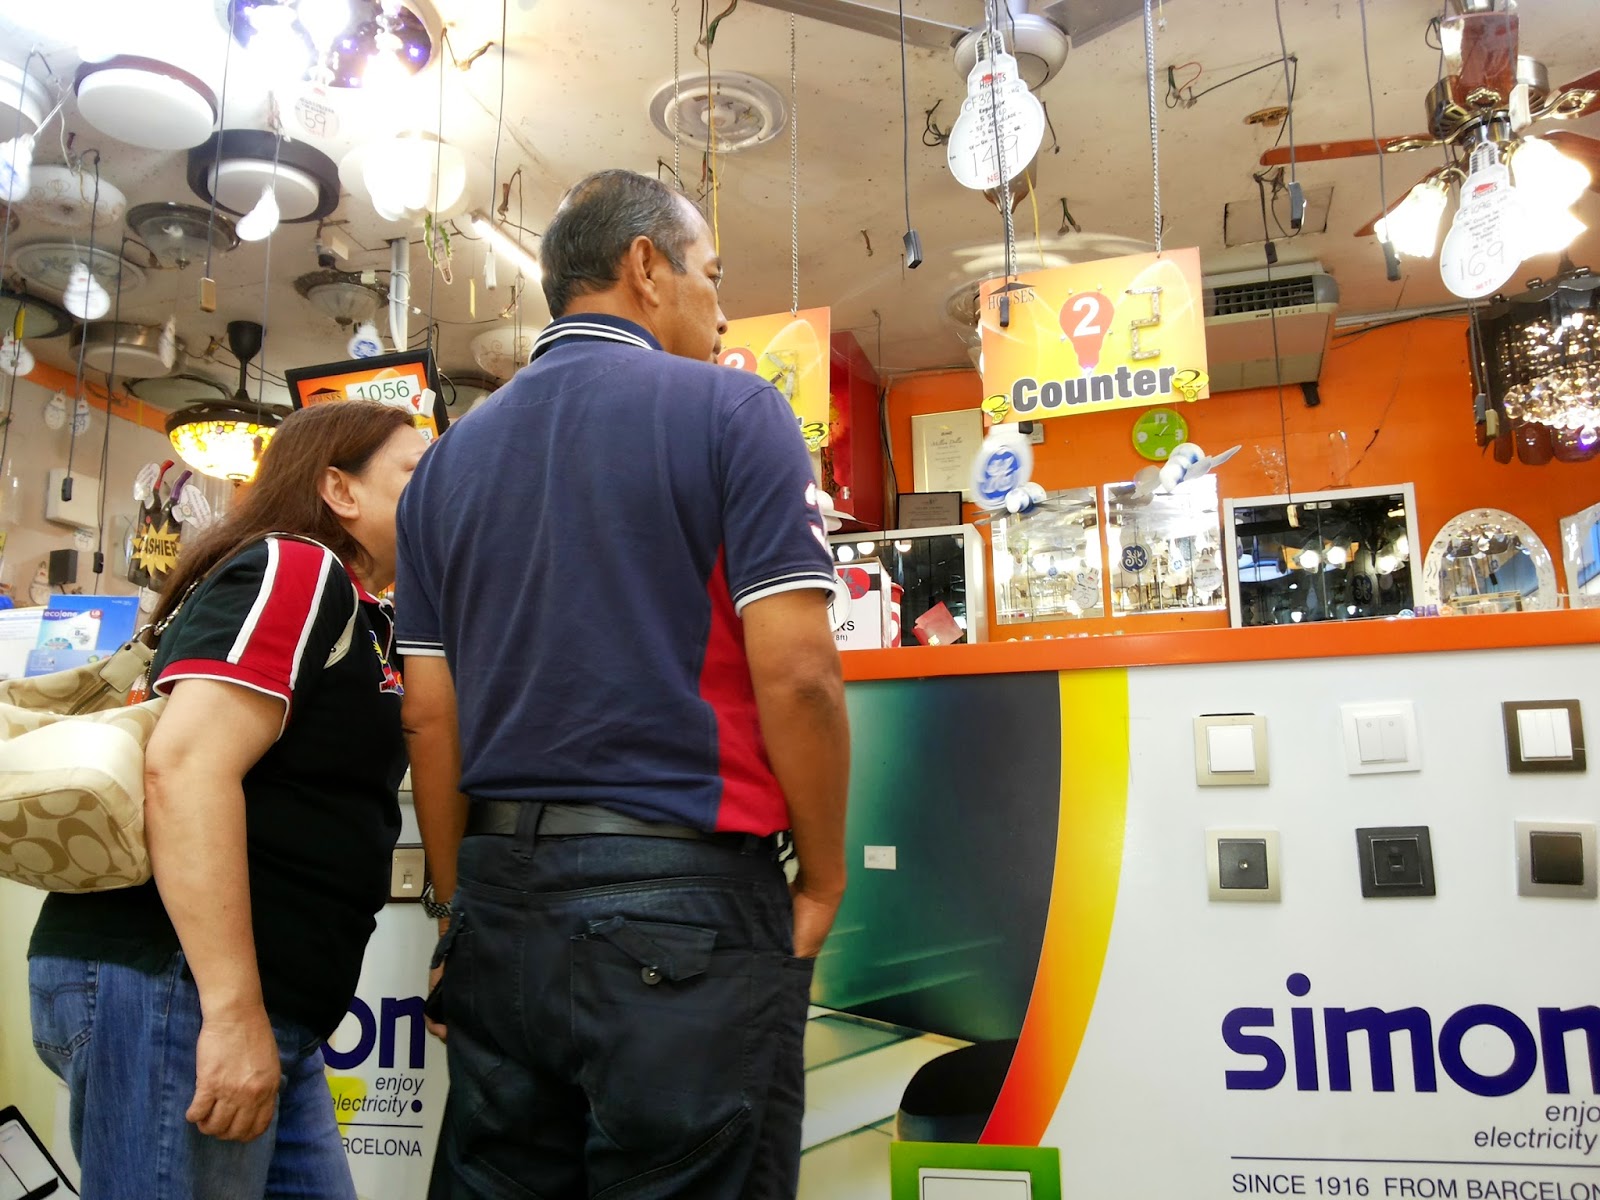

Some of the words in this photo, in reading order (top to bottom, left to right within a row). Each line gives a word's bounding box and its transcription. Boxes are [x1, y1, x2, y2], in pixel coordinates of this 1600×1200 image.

[304, 109, 326, 138] 59
[973, 134, 1019, 178] 149
[1459, 240, 1505, 281] 169
[1072, 296, 1101, 338] 2
[356, 379, 410, 401] 1056
[1012, 366, 1176, 412] Counter
[1154, 413, 1167, 424] 12
[1175, 428, 1184, 441] 3
[1221, 972, 1600, 1097] simon
[375, 1073, 425, 1096] enjoy
[1474, 1126, 1598, 1156] electricity
[1232, 1173, 1307, 1195] SINCE
[1314, 1176, 1370, 1197] 1916
[1384, 1177, 1458, 1200] FROM
